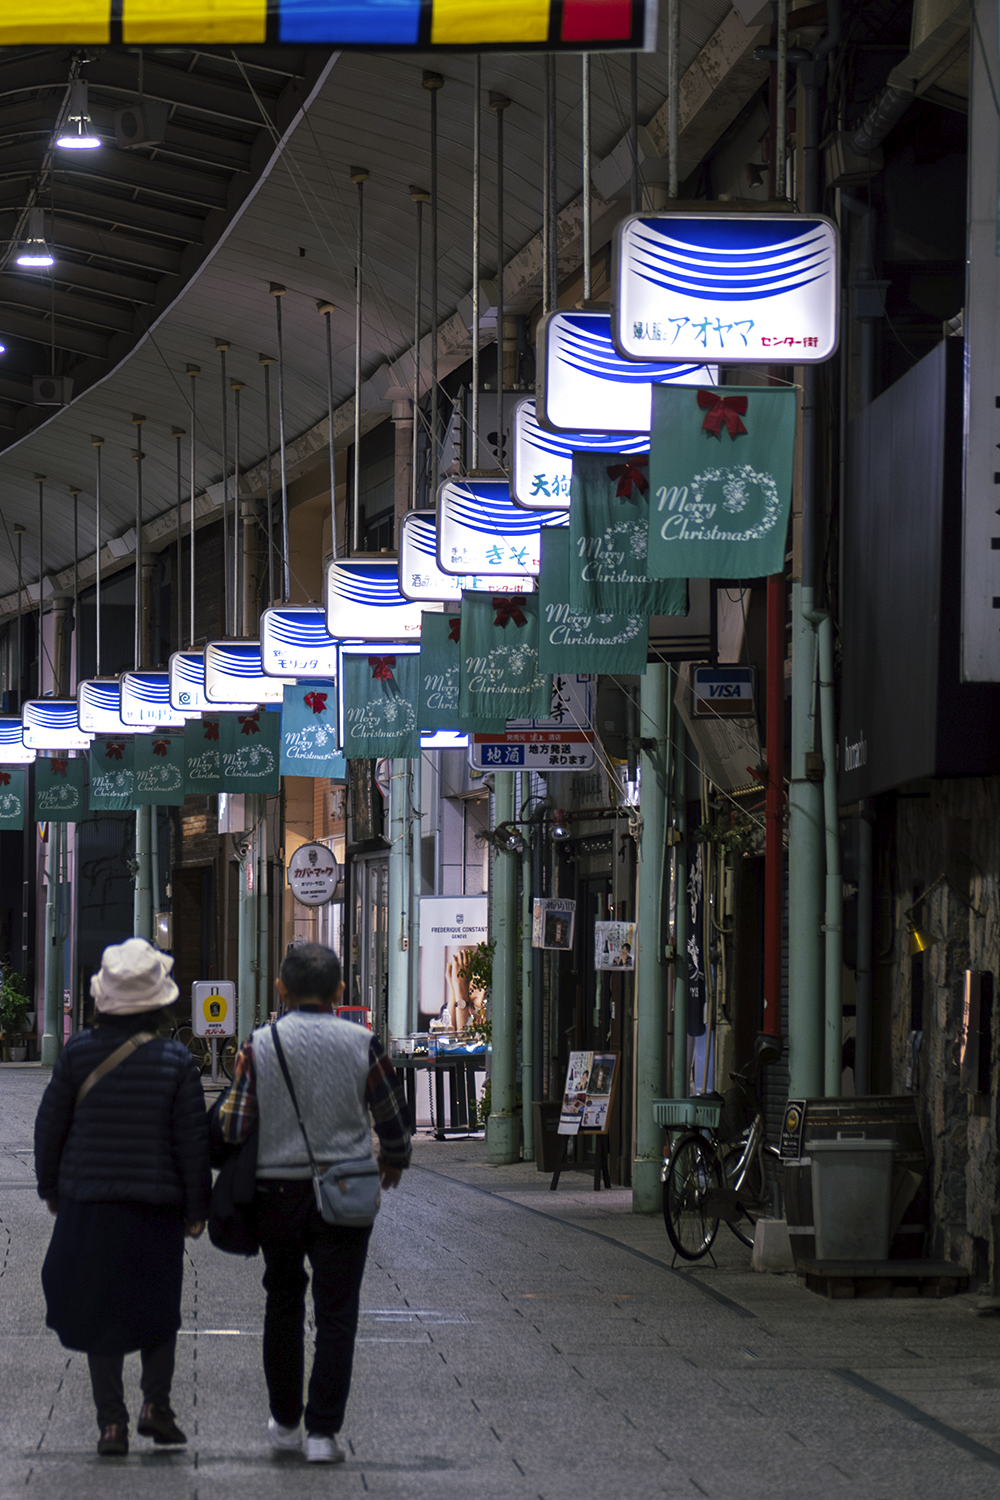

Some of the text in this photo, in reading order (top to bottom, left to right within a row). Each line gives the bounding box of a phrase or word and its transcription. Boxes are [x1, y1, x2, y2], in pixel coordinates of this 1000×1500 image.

[667, 316, 755, 348] アオヤマ
[761, 336, 819, 348] センター街
[656, 486, 717, 519] Merry
[661, 514, 751, 541] Christmas
[577, 536, 625, 565] Merry
[545, 603, 591, 628] Merry
[550, 624, 617, 646] Christmas
[465, 657, 504, 677] Merry
[424, 674, 459, 696] Merry
[468, 675, 528, 693] Christmas
[708, 685, 741, 697] VISA
[347, 707, 380, 727] Merry
[285, 732, 313, 749] Merry
[350, 723, 400, 738] Christmas
[286, 746, 329, 760] Christmas
[486, 744, 571, 764] 地酒 地方発送
[549, 755, 587, 765] 承ります
[294, 866, 334, 879] カバーマーク
